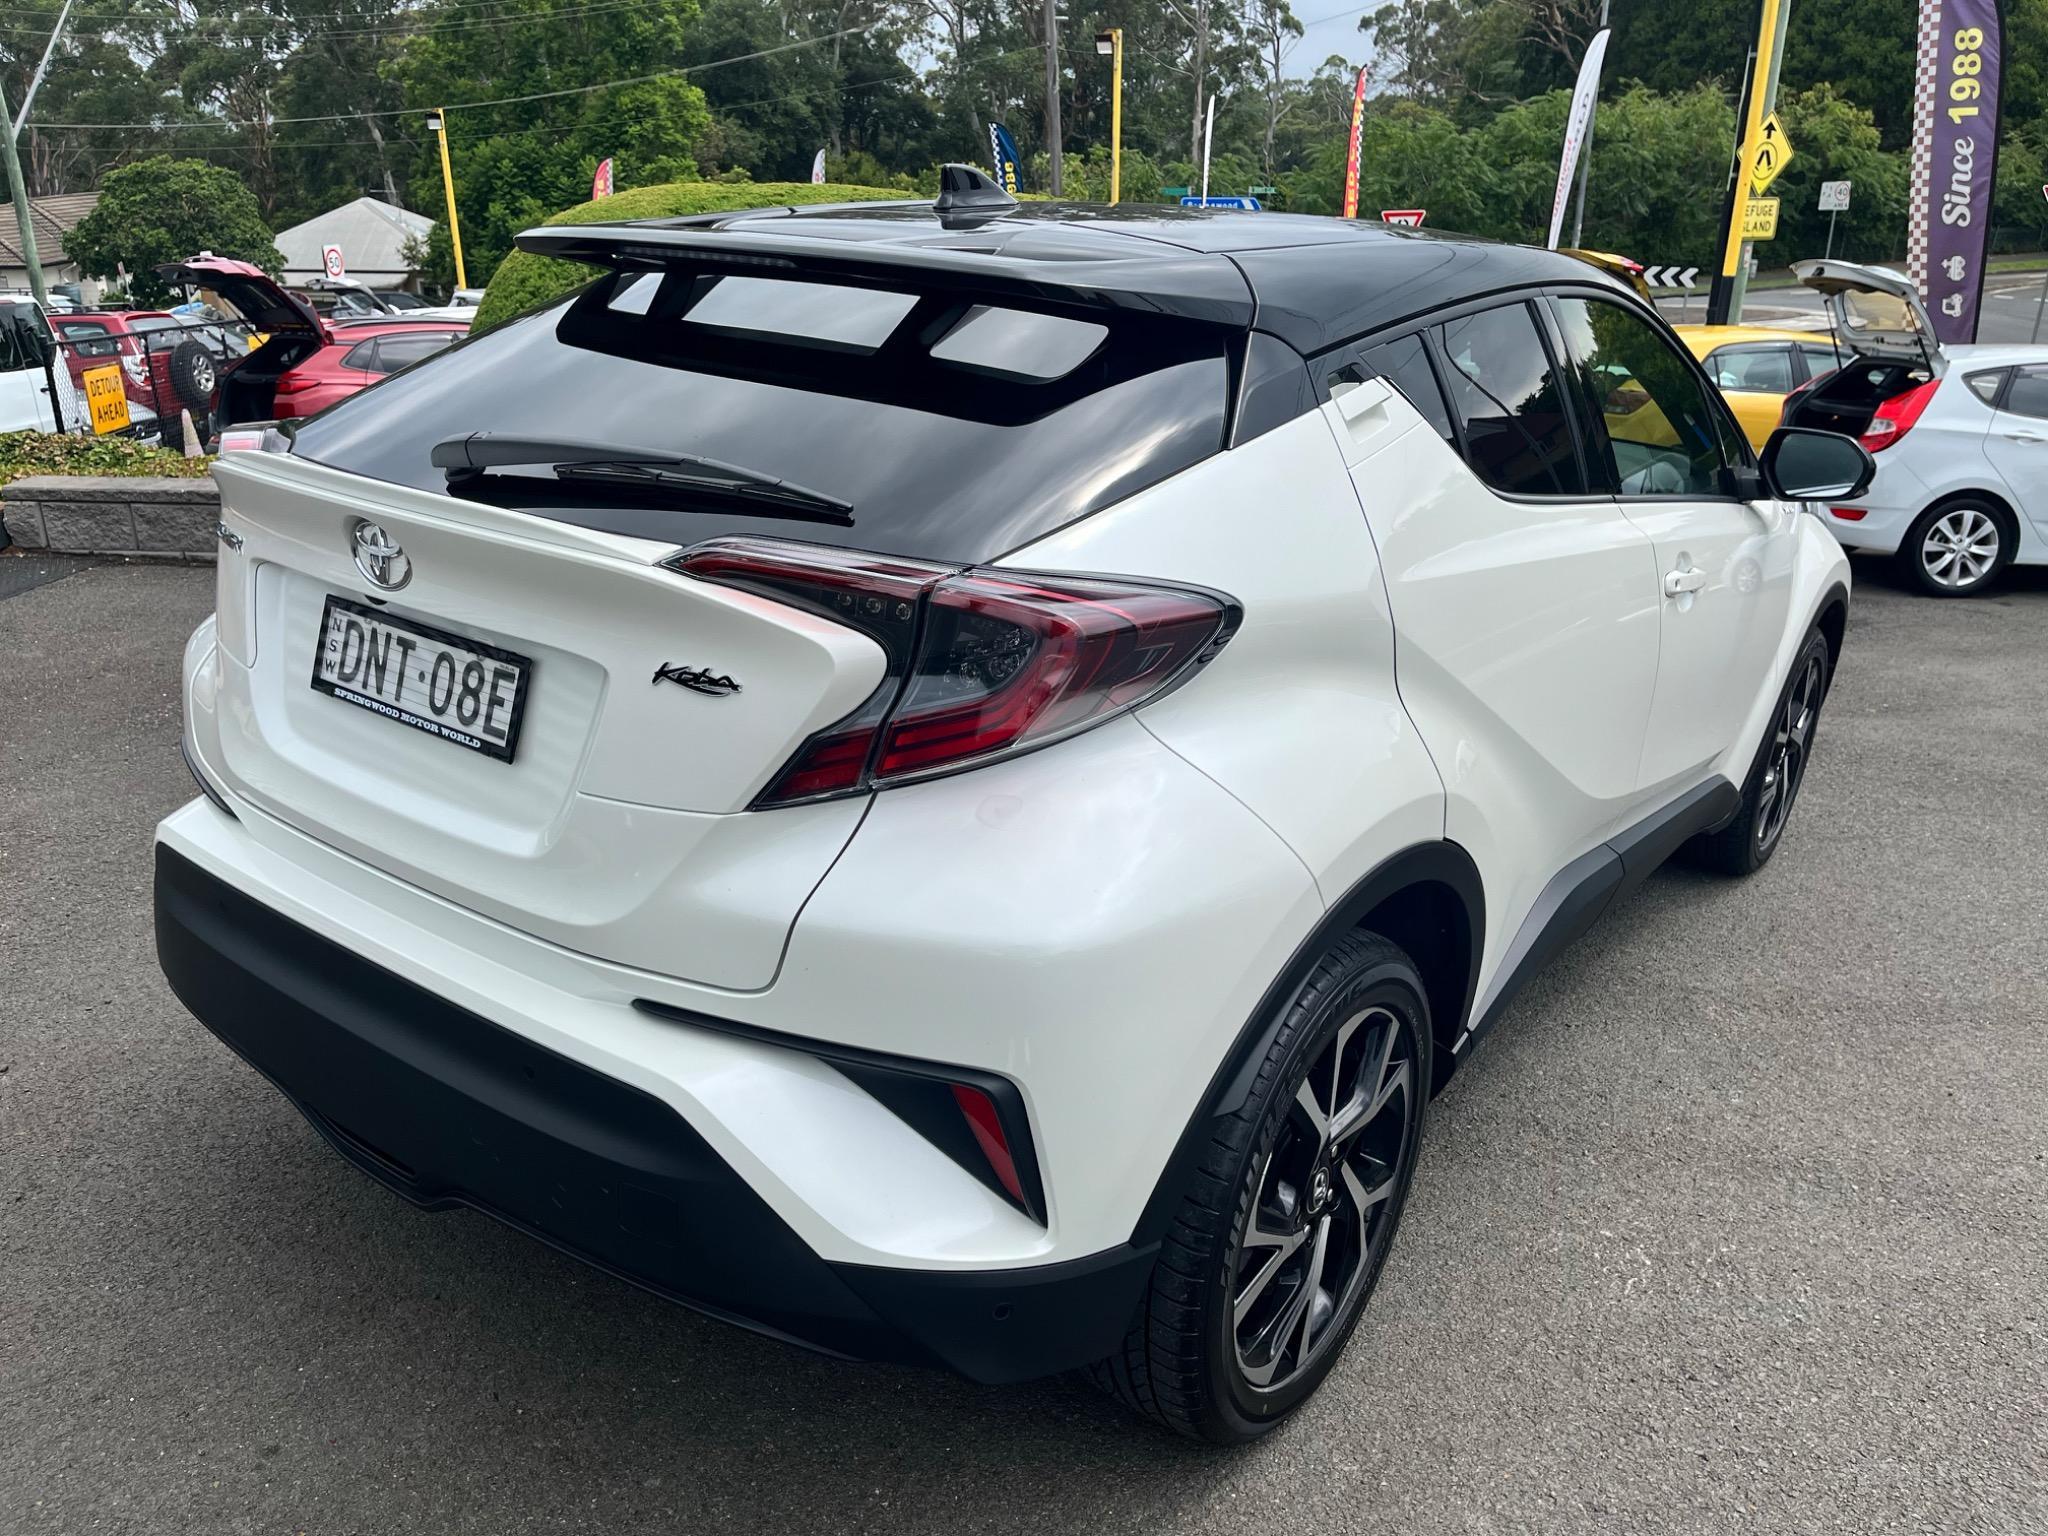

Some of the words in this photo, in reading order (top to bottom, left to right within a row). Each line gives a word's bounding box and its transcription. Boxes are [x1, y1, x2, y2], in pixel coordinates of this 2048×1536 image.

[1948, 27, 1984, 125] 1988
[1942, 136, 1975, 228] Since
[1745, 205, 1774, 217] EFUGE
[329, 257, 340, 269] 50
[89, 375, 121, 397] DETOUR
[97, 401, 125, 425] AHEAD
[334, 687, 400, 718] SPRINGWOOD
[401, 712, 439, 734] MOTOR
[441, 725, 481, 749] WORLD
